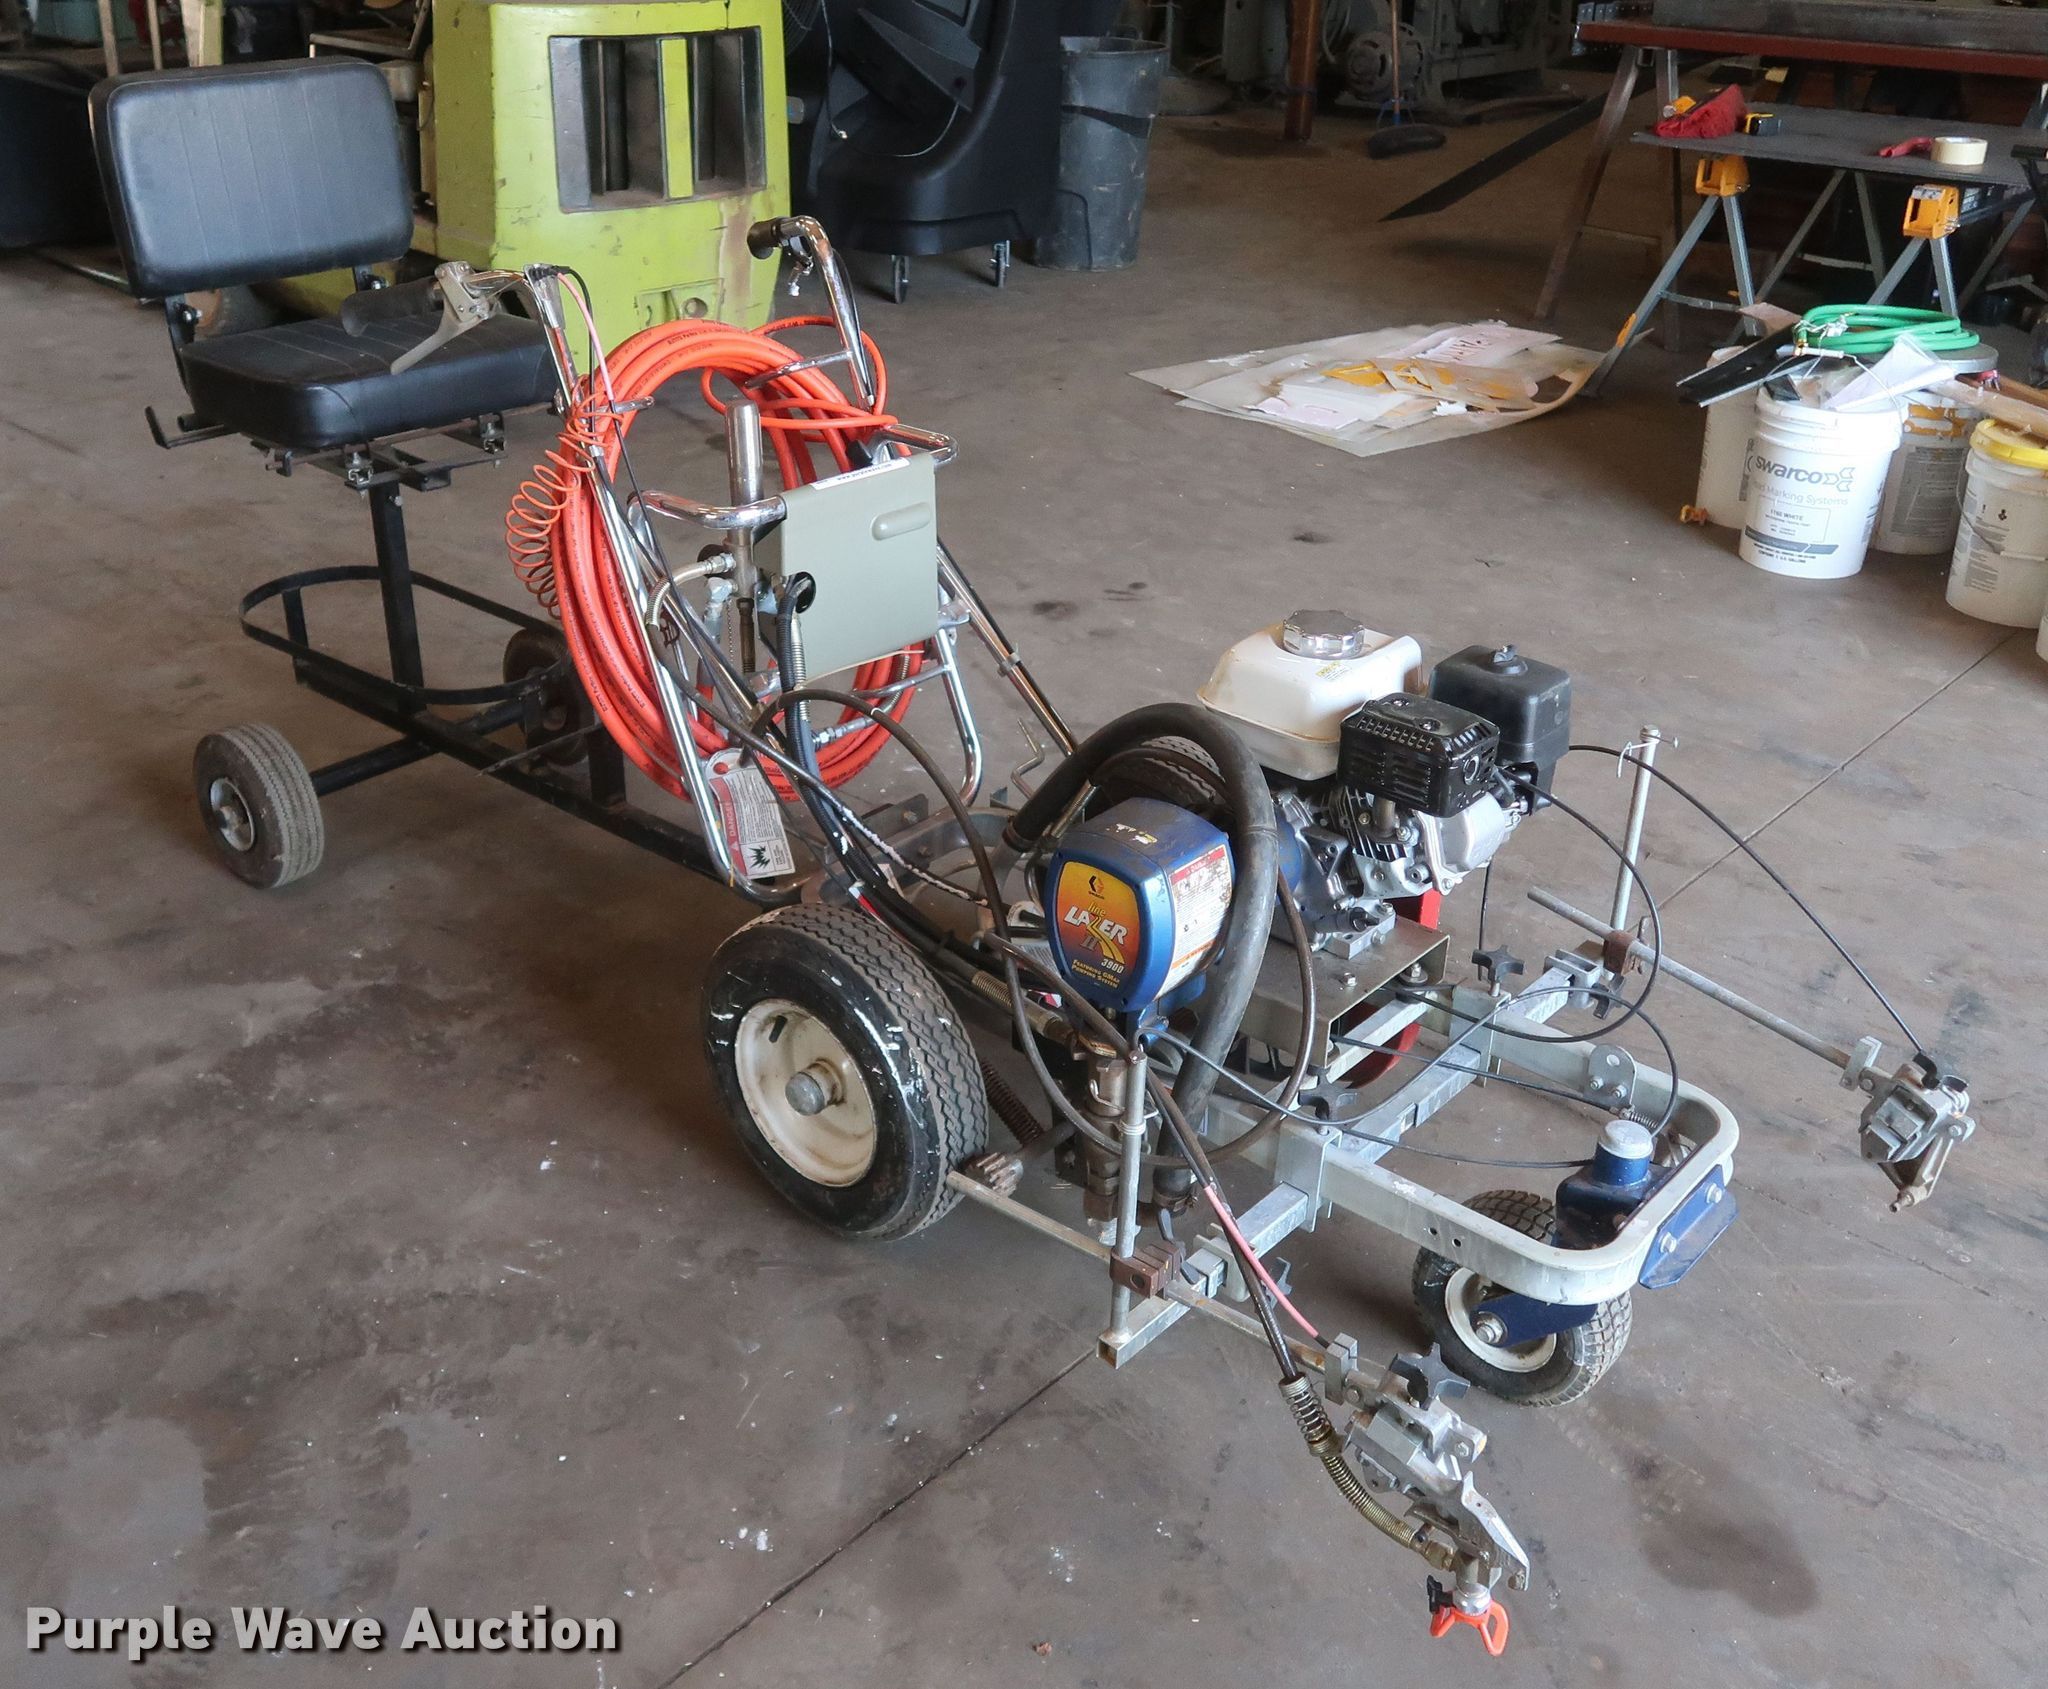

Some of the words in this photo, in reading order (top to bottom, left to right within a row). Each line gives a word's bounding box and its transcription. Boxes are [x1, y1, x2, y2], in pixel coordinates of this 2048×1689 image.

[1756, 455, 1823, 484] swarco
[1088, 901, 1106, 917] line
[1064, 906, 1128, 945] LAZER
[1101, 958, 1124, 973] 3900
